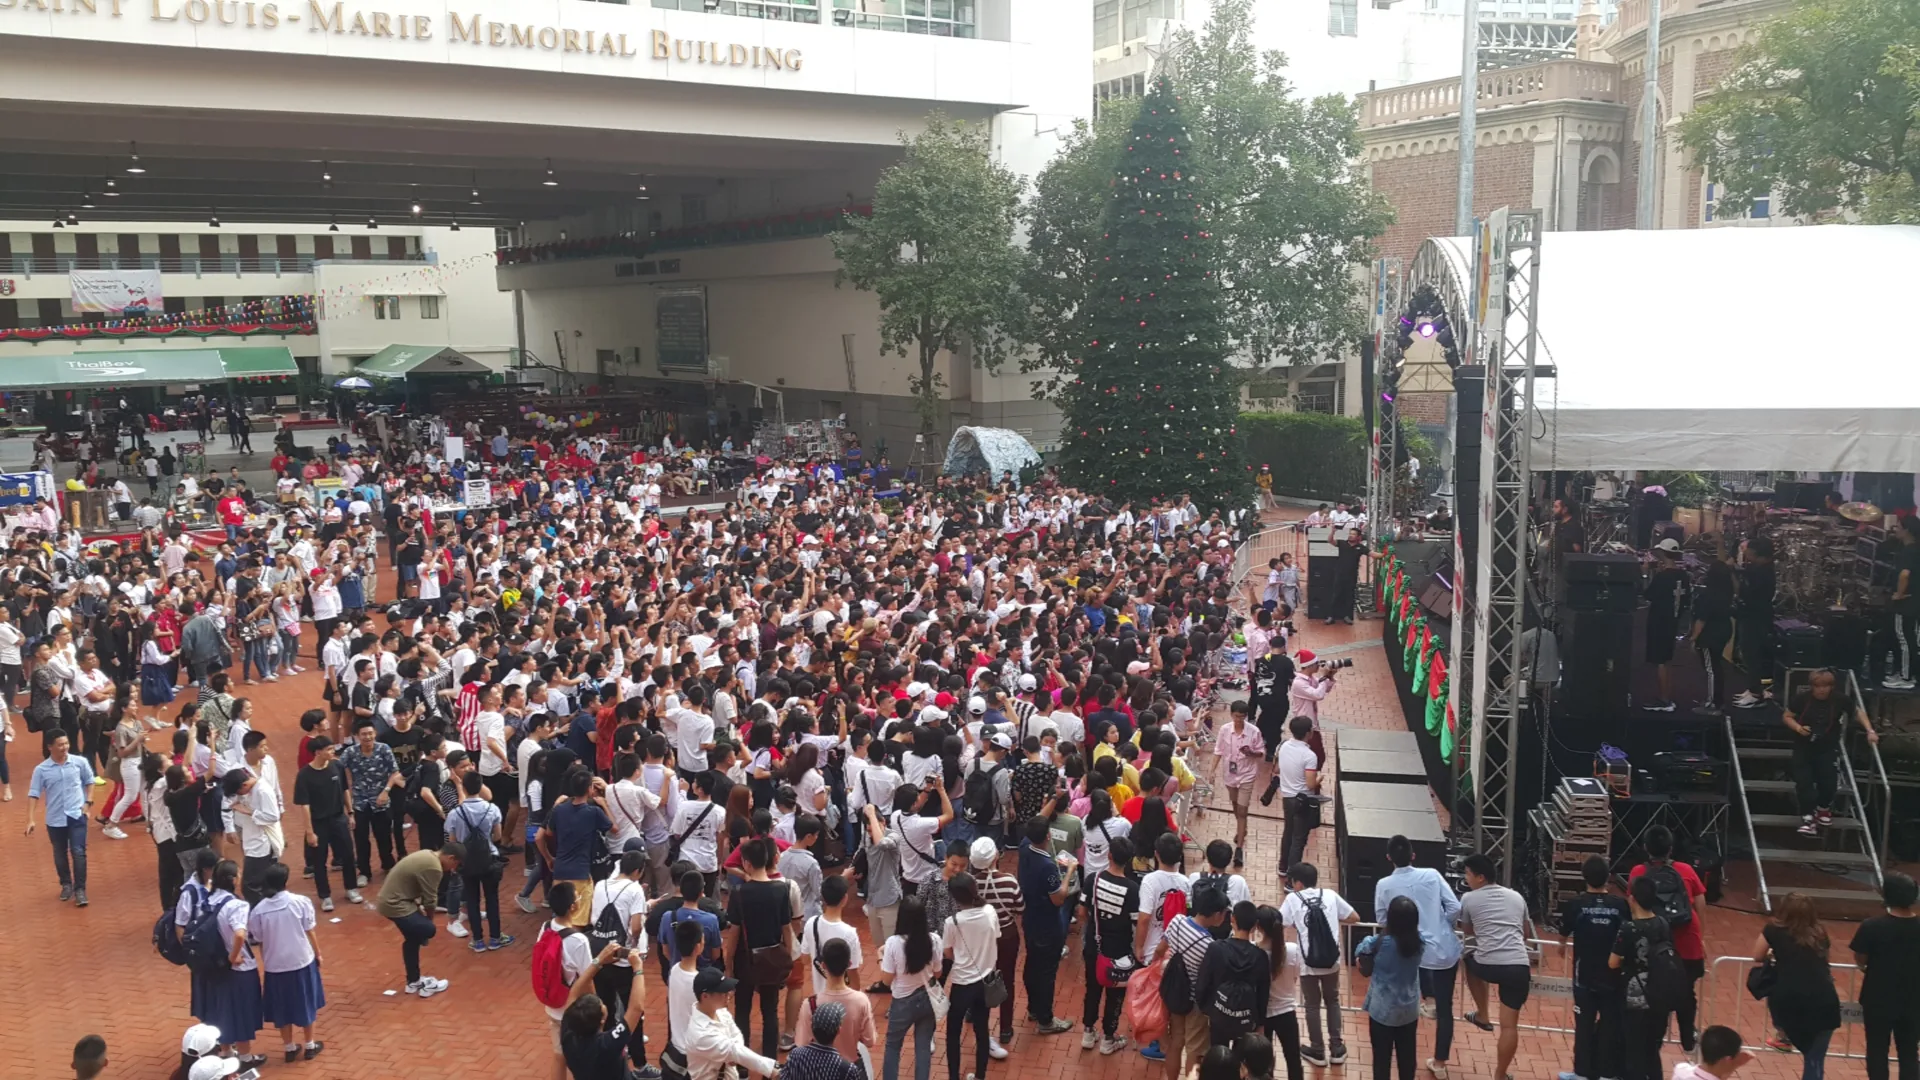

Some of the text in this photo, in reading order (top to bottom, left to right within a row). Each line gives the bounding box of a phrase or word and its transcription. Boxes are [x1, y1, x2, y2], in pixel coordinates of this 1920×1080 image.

[0, 0, 123, 16] INT
[449, 11, 638, 58] MEMORIAL
[650, 28, 804, 72] BUILDING
[65, 360, 135, 369] ThaiBev
